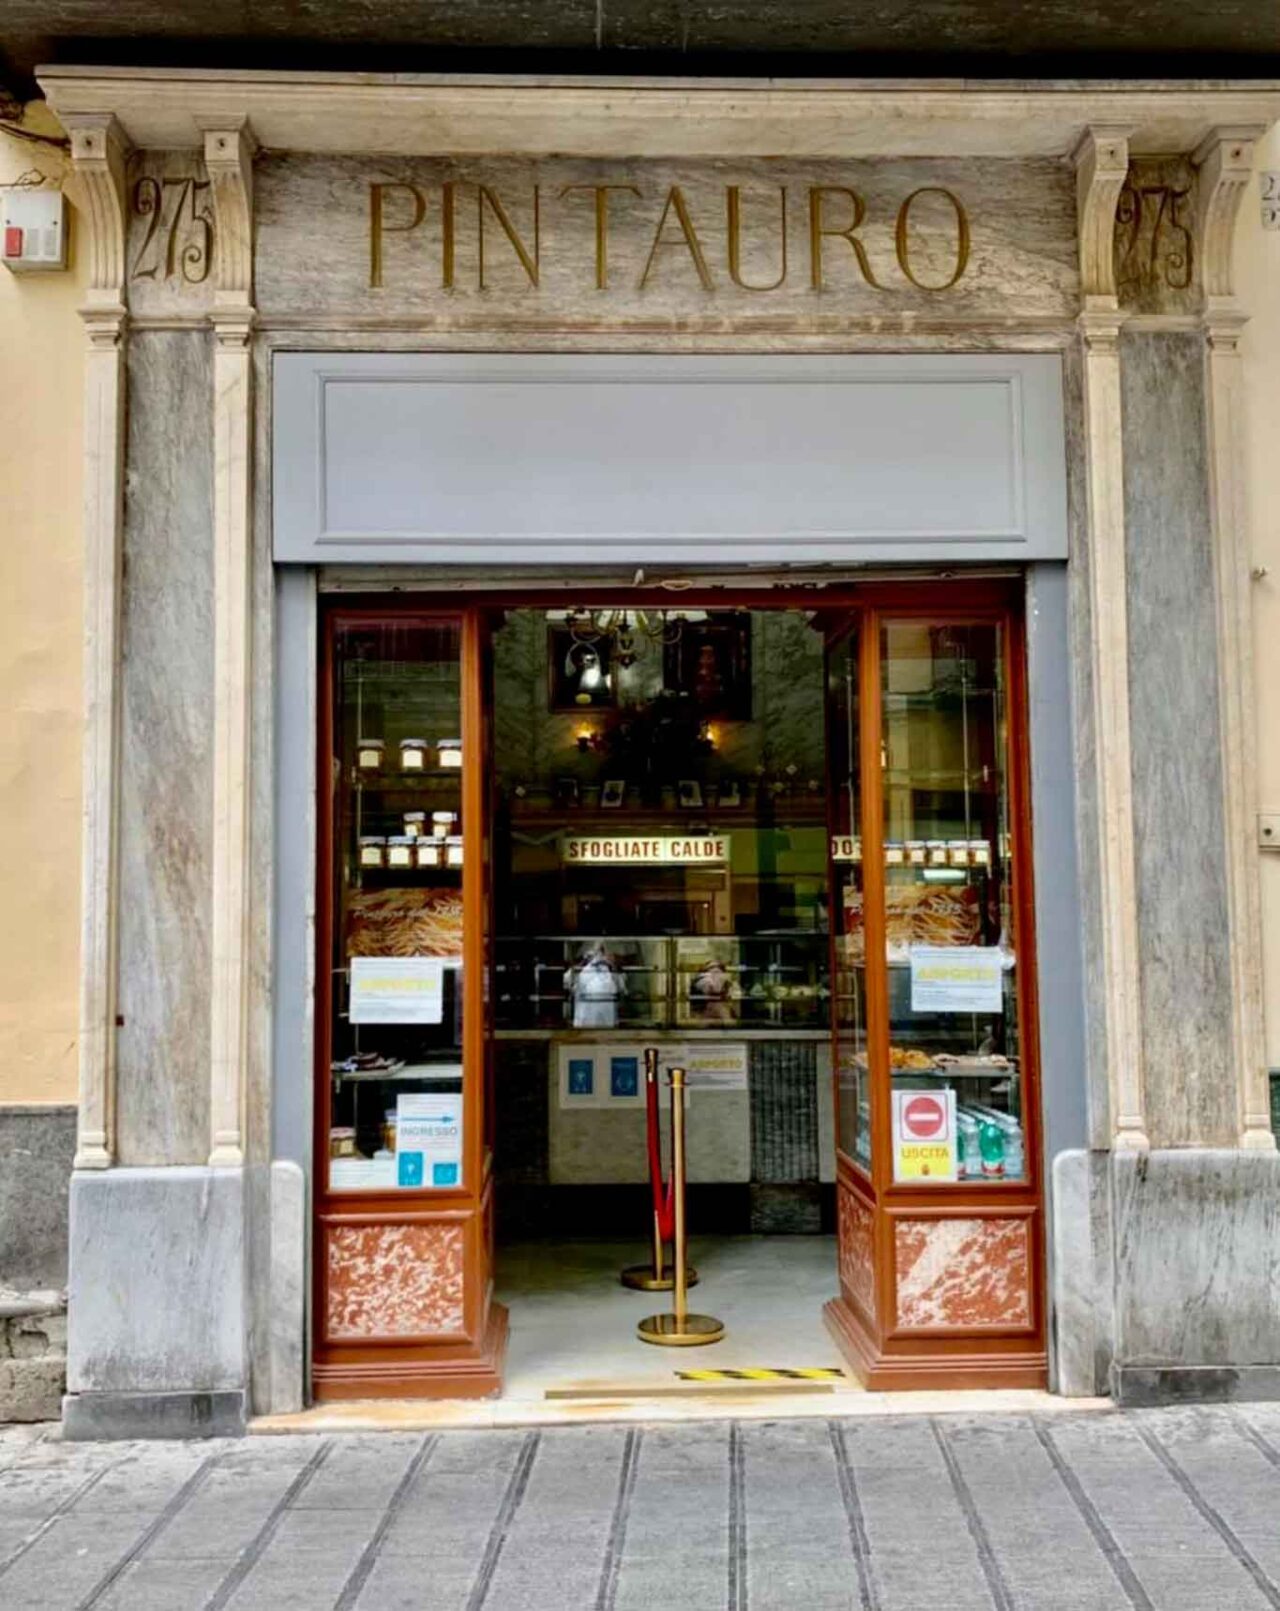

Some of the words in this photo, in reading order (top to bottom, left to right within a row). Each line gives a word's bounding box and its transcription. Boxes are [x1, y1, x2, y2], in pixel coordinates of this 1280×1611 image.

[133, 176, 213, 284] 275
[370, 182, 969, 292] PINTAURO
[569, 839, 660, 860] SFOGLIATE
[670, 839, 726, 859] CALDE
[901, 1147, 949, 1159] USCITA
